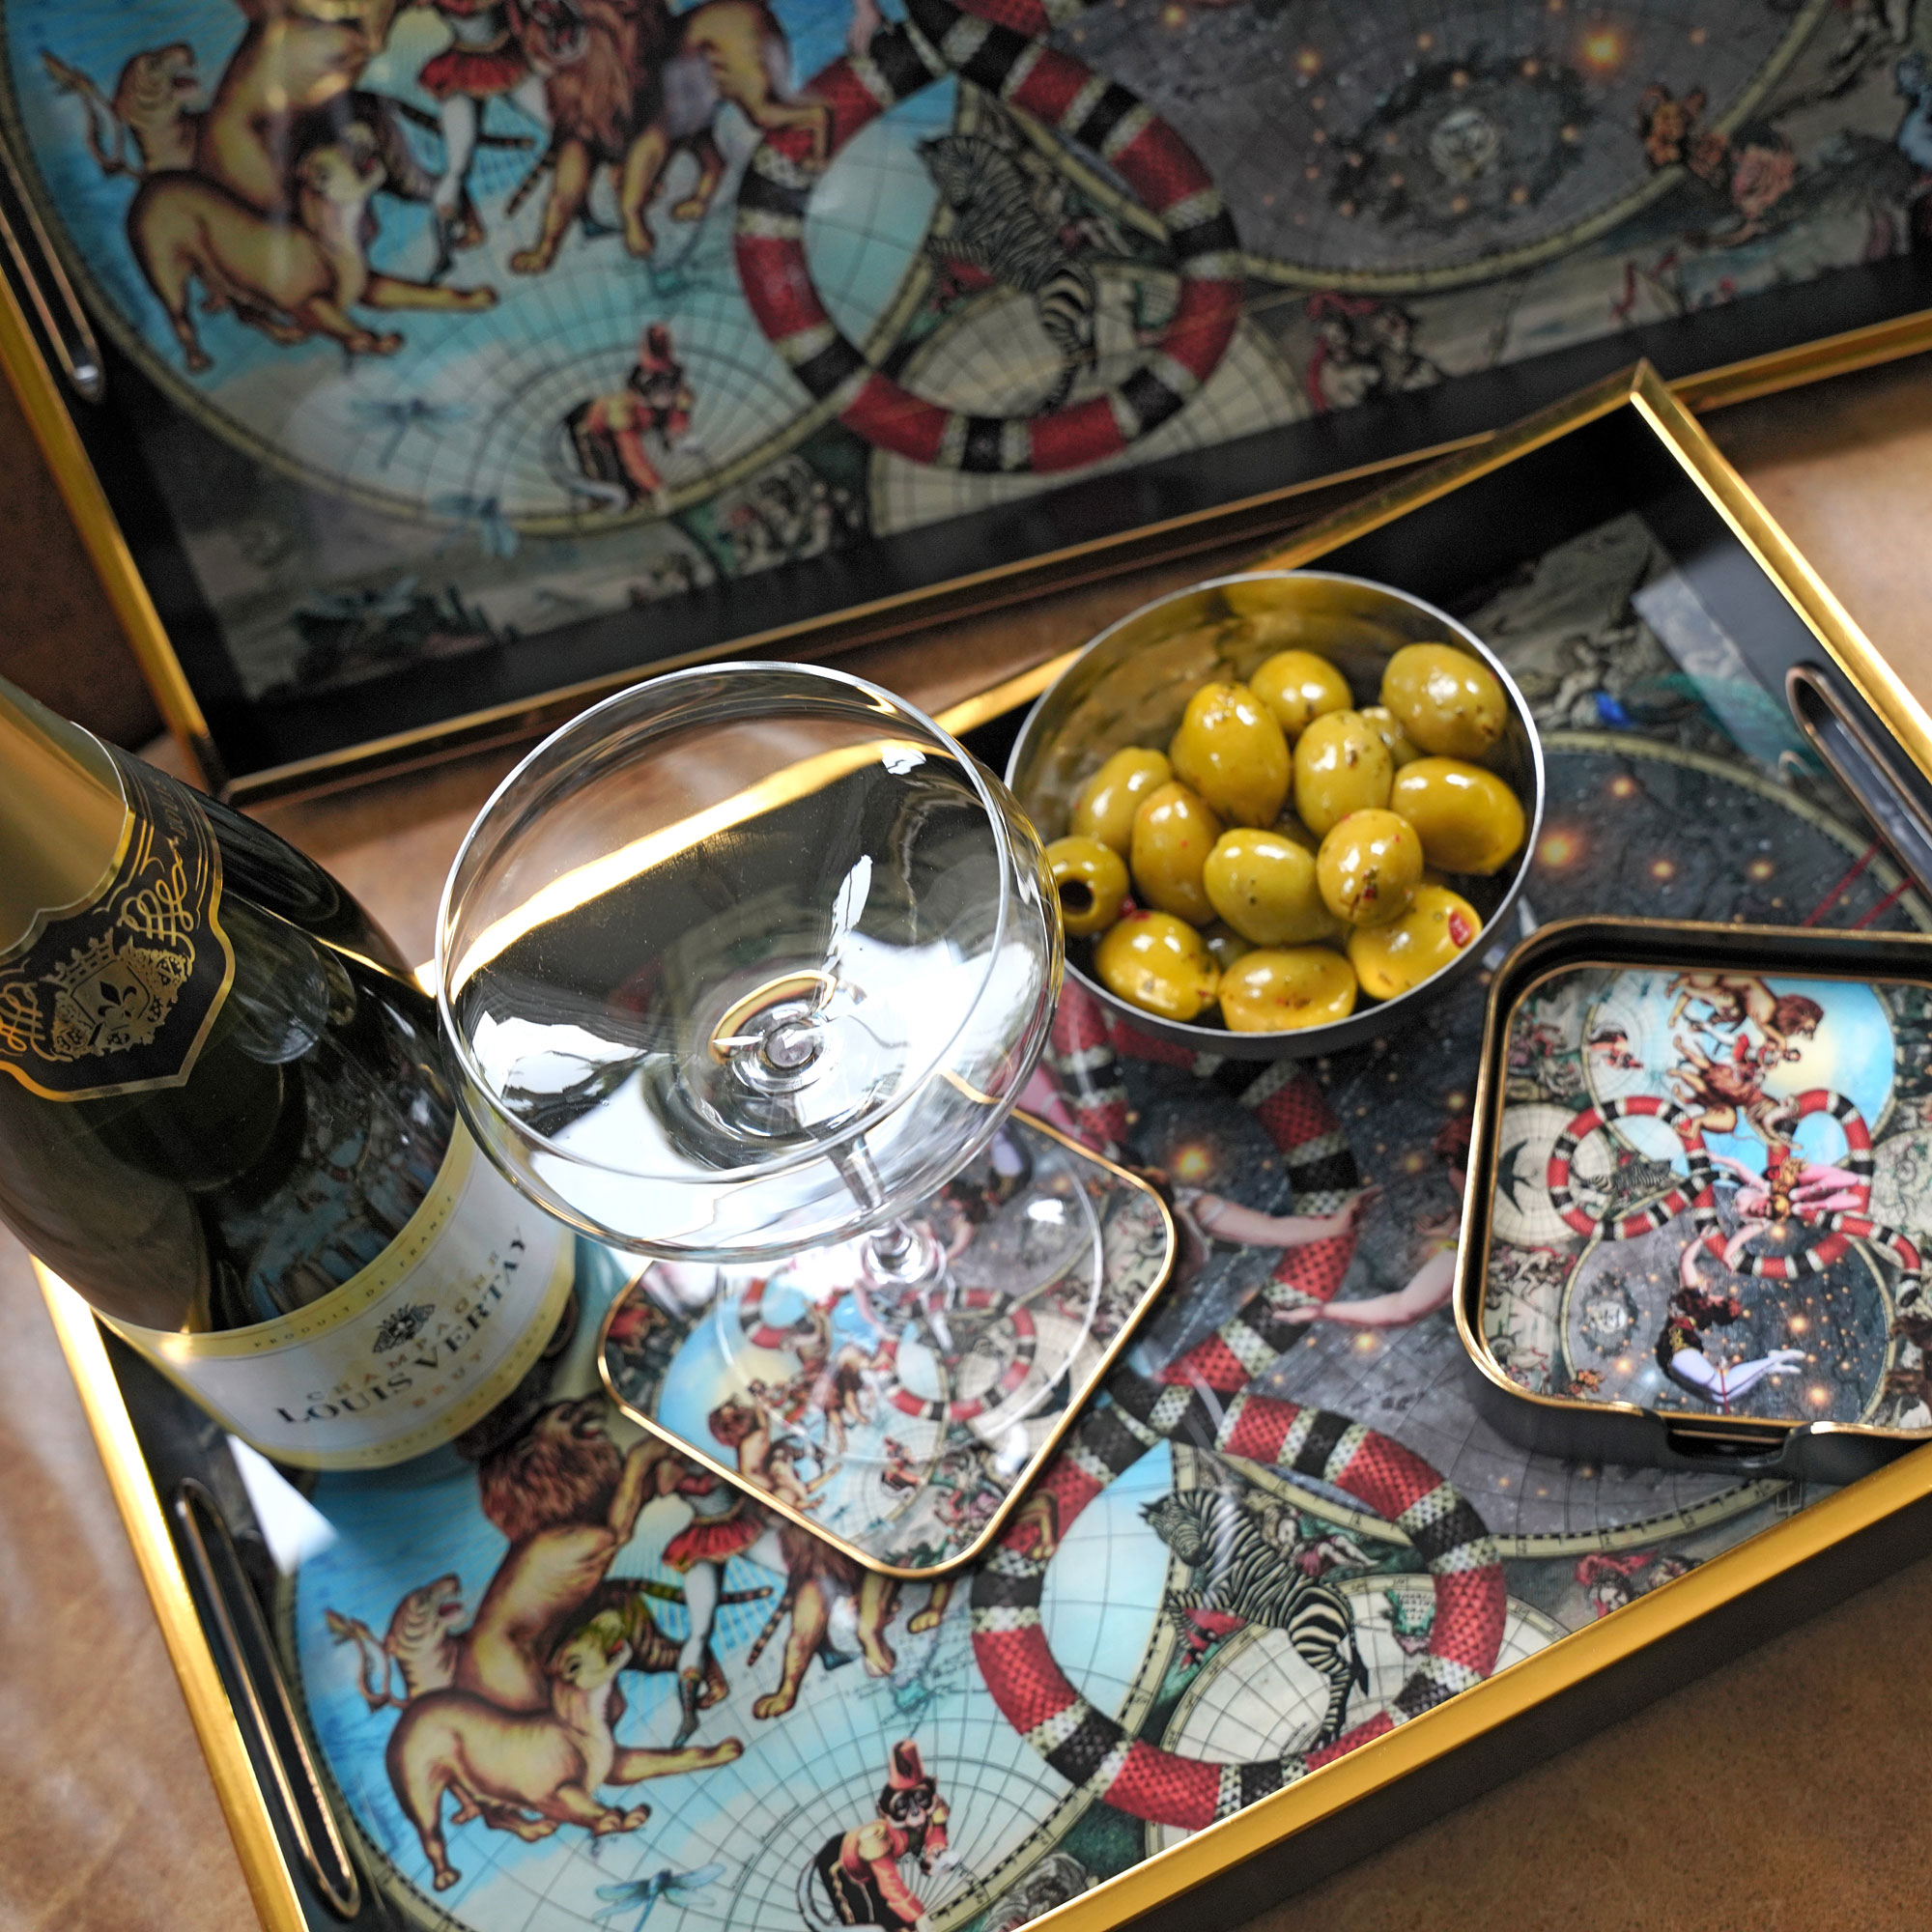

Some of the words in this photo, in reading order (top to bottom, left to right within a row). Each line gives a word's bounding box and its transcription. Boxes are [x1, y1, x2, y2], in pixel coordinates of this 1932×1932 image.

[254, 1306, 350, 1348] PRODUIT
[365, 1278, 387, 1298] DE
[399, 1195, 453, 1268] FRANCE
[274, 1372, 413, 1424] LOUIS
[413, 1224, 526, 1370] VERTAY
[305, 1250, 500, 1402] CHAMPAGNE
[412, 1351, 482, 1408] BRUT
